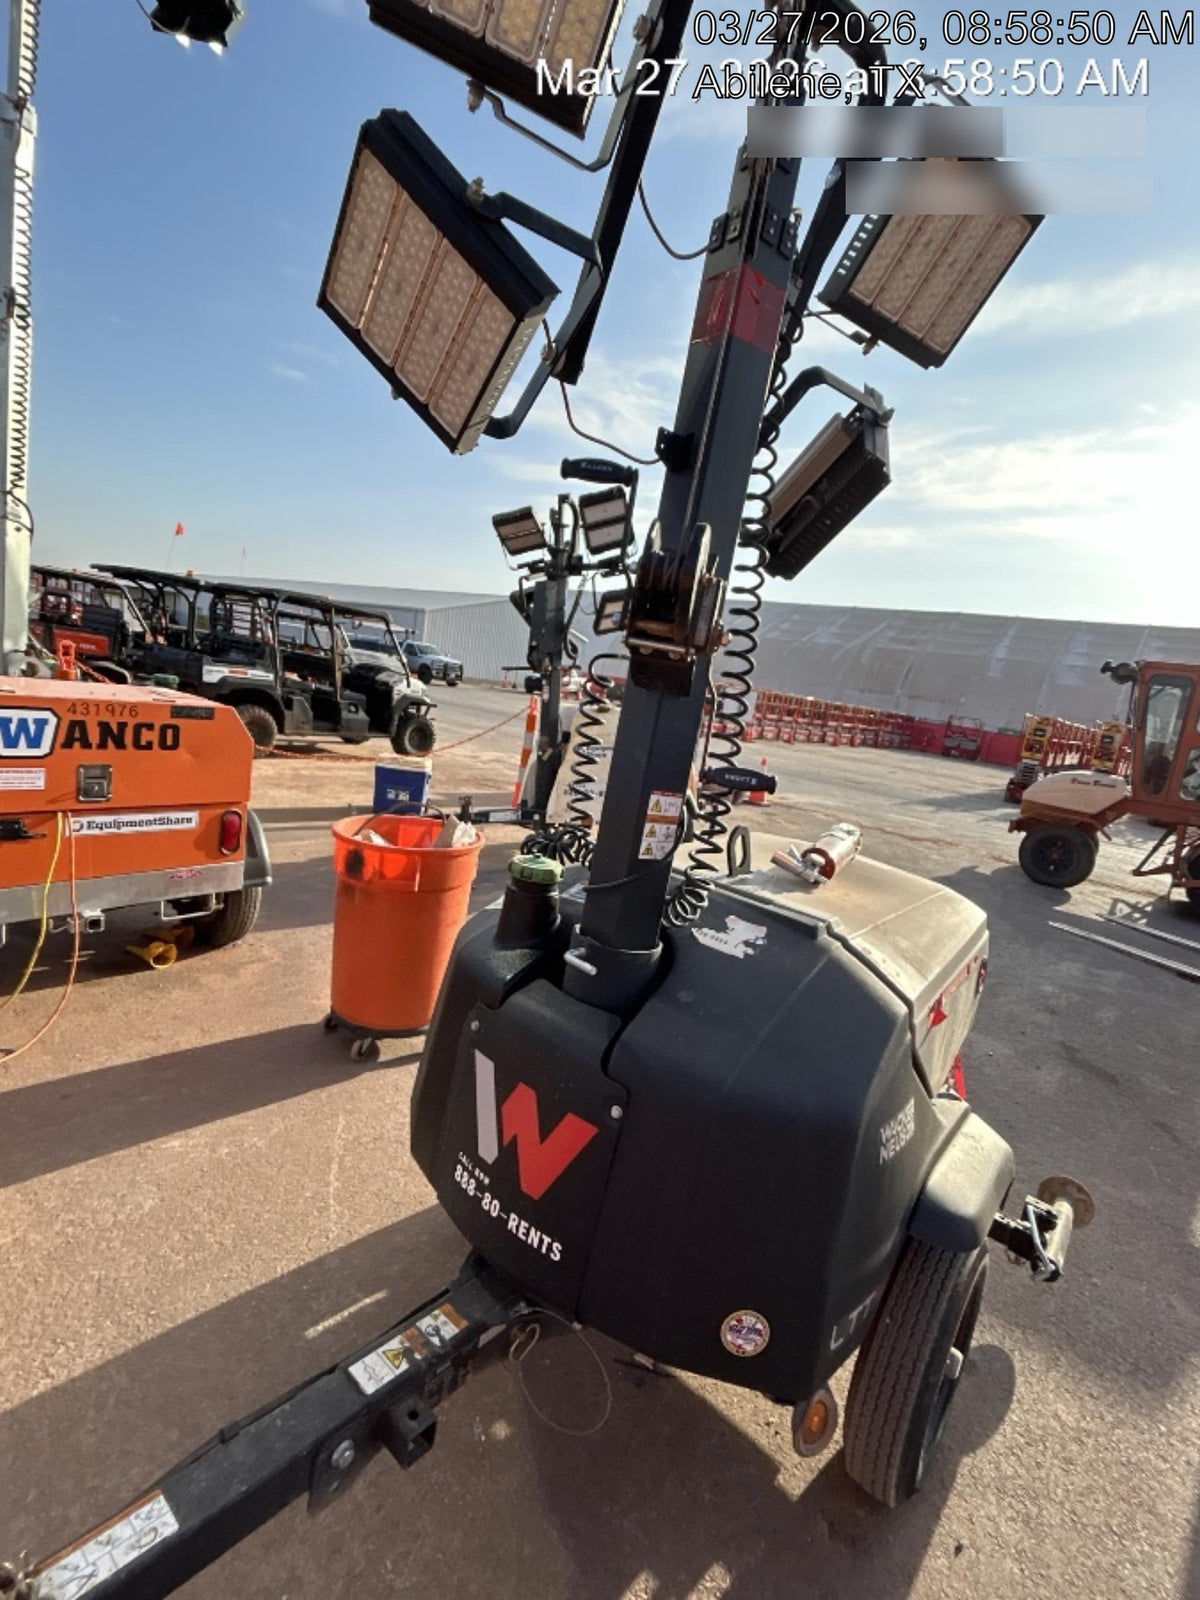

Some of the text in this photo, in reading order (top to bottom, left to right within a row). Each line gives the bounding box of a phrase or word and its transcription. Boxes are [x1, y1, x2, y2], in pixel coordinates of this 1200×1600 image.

[66, 702, 139, 718] 431976
[86, 816, 194, 832] EquipmentShare
[454, 1164, 563, 1262] 888-80-RENTS
